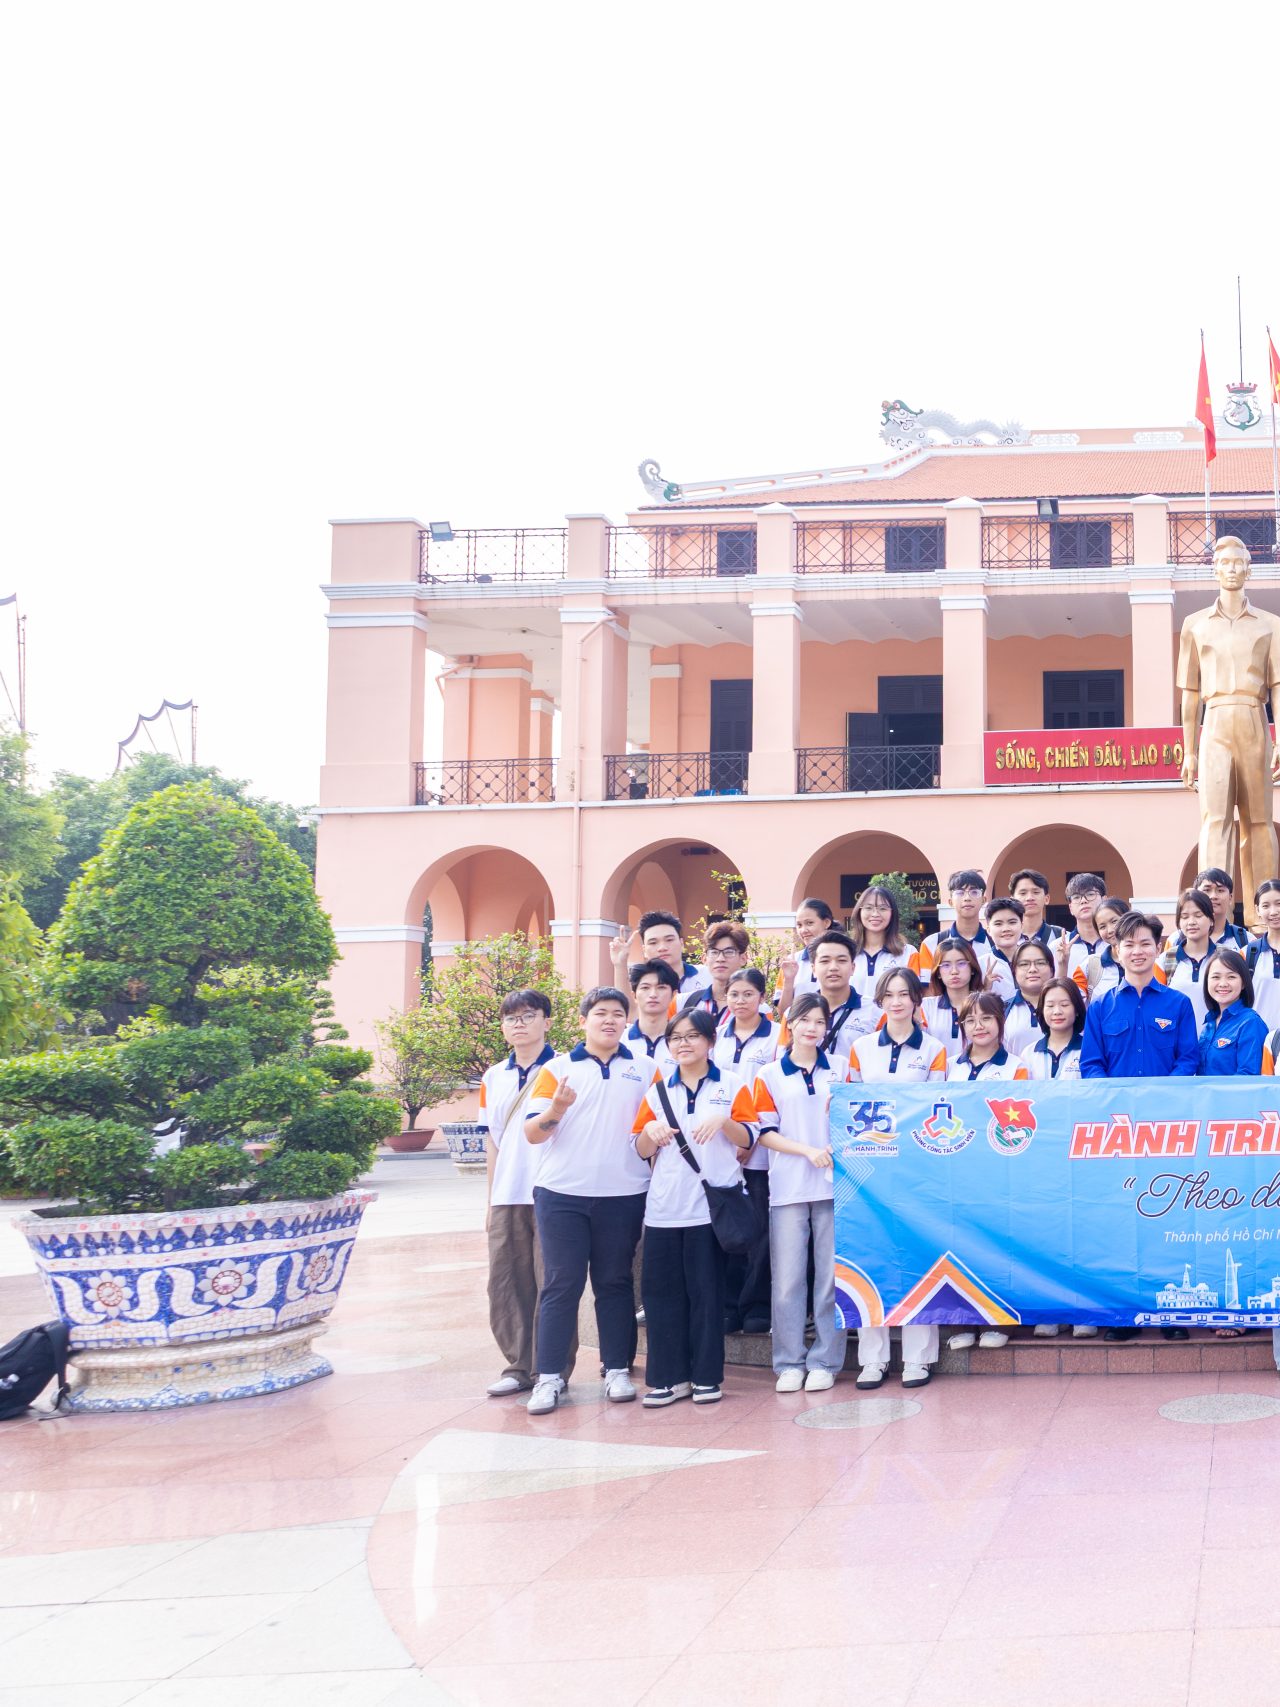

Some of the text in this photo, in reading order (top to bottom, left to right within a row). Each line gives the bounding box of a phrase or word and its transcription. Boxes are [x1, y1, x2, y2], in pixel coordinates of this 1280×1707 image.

[995, 739, 1041, 772] SỐNG,
[1045, 739, 1089, 768] CHIẾN
[1094, 738, 1127, 769] ĐẤU,
[1131, 744, 1158, 766] LAO
[847, 1101, 896, 1137] 35
[1068, 1114, 1202, 1159] HÀNH
[1164, 1230, 1202, 1243] Thành
[1205, 1227, 1230, 1244] phố
[1233, 1227, 1250, 1241] Hồ
[1253, 1229, 1274, 1240] Chí
